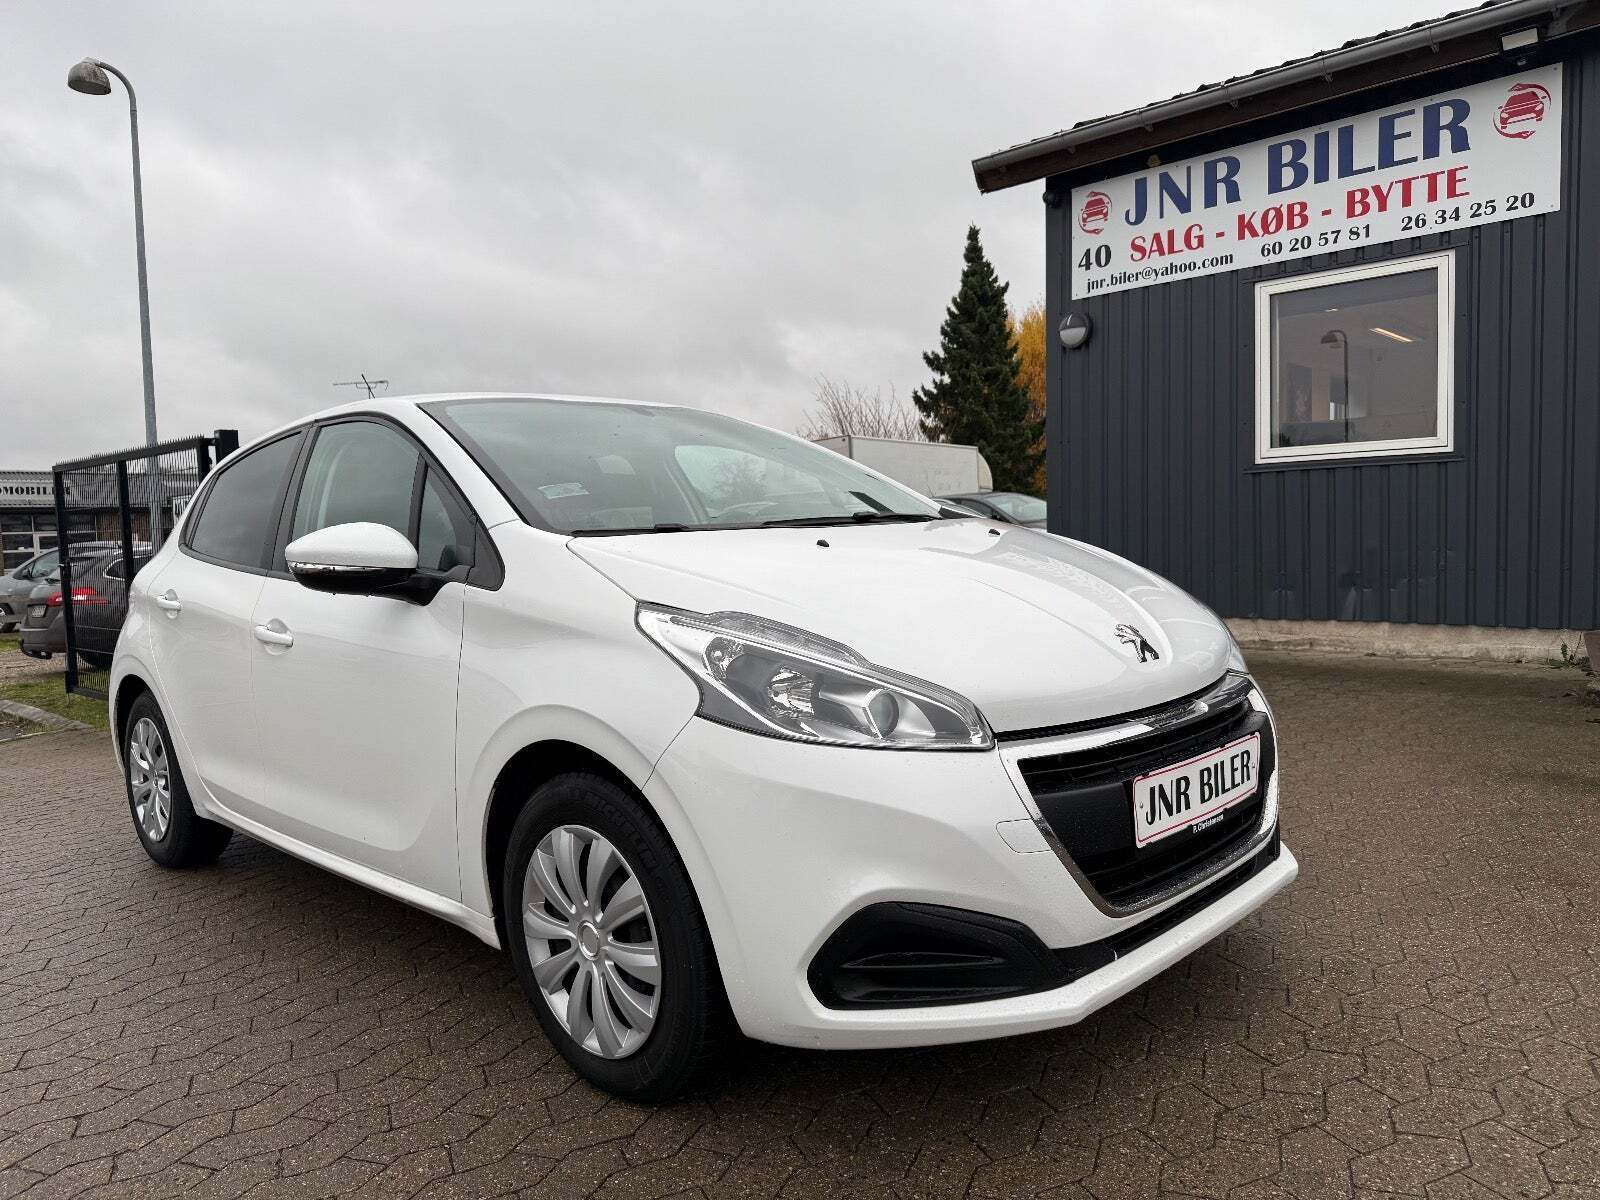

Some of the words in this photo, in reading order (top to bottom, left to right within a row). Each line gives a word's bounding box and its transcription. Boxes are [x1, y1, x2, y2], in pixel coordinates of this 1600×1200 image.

[1125, 155, 1242, 226] JNR
[1268, 98, 1472, 195] BILER
[1130, 223, 1205, 262] SALG
[1238, 201, 1309, 240] KØB
[1346, 165, 1470, 220] BYTTE
[1401, 212, 1427, 232] 26
[1434, 206, 1462, 225] 34
[1469, 199, 1497, 218] 25
[1505, 192, 1535, 211] 20
[1078, 244, 1112, 271] 40
[1261, 240, 1283, 258] 60
[1289, 235, 1311, 252] 20
[1318, 229, 1342, 247] 57
[1348, 223, 1370, 241] 81
[1087, 252, 1234, 293] jnr.biler@yahoo.com
[1146, 775, 1191, 826] JNR
[1200, 749, 1251, 805] BILER
